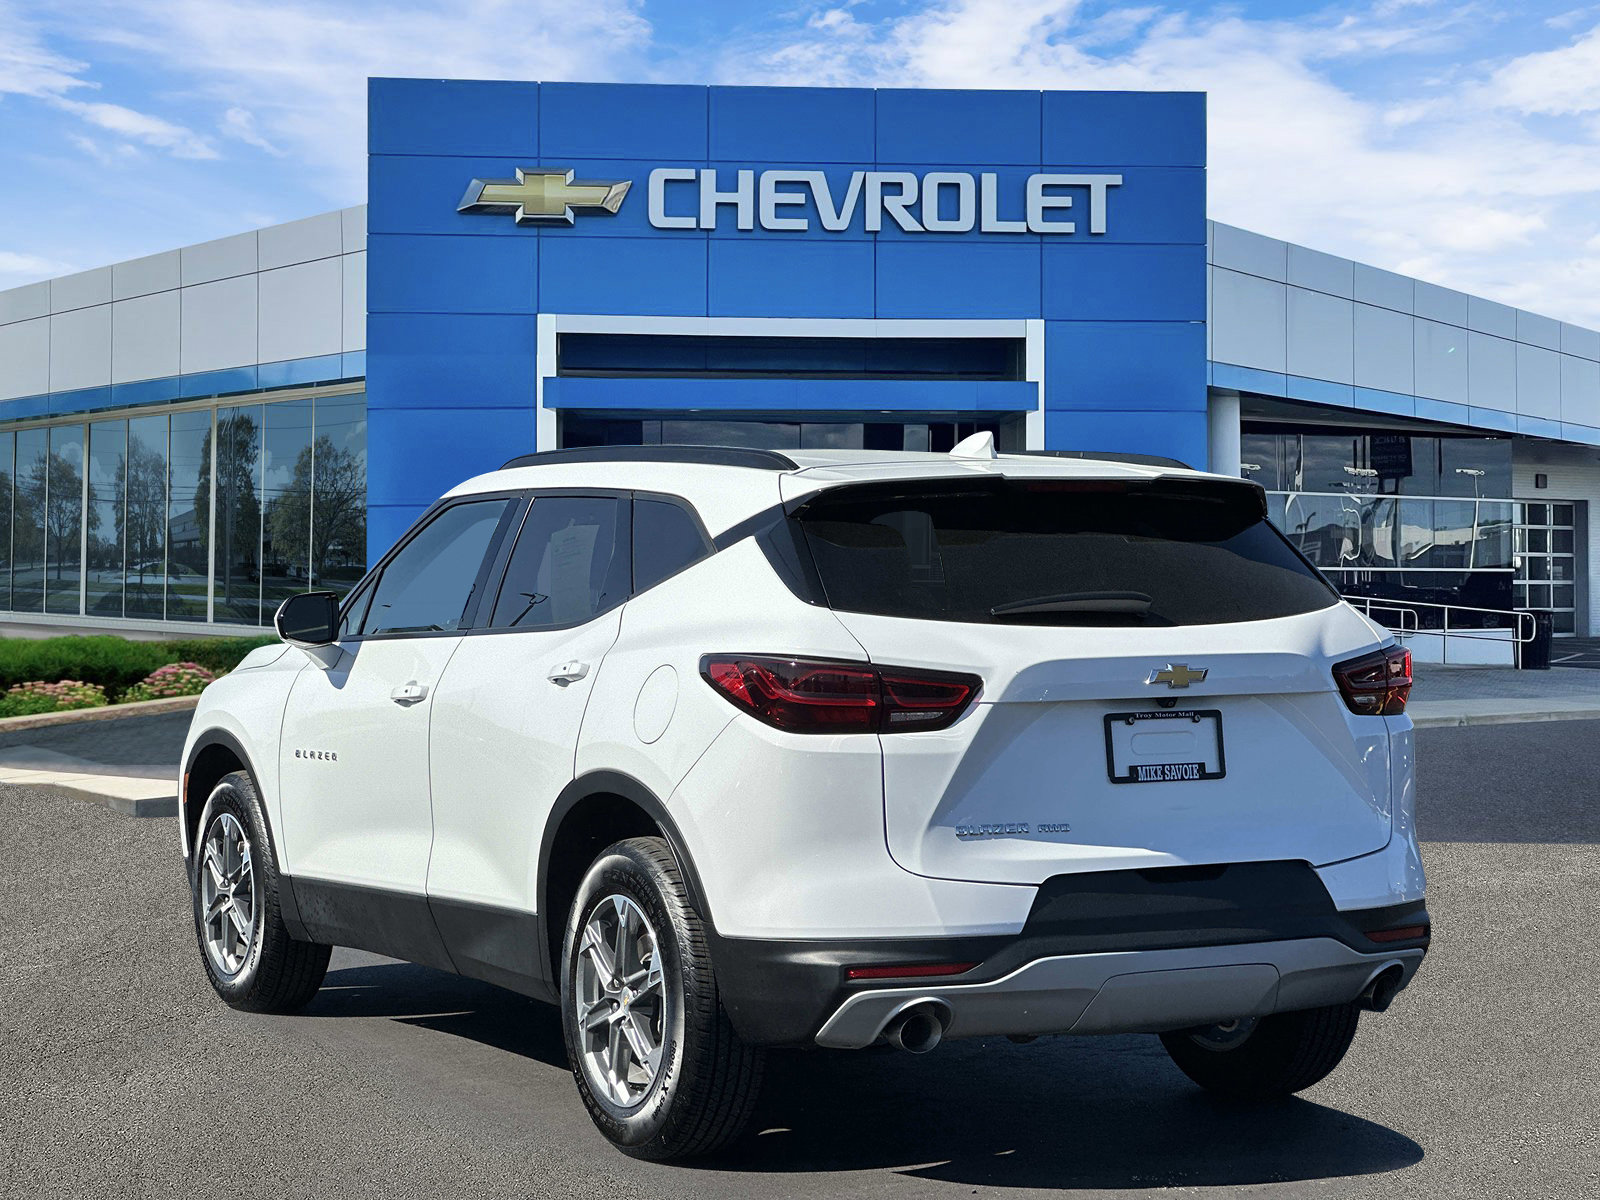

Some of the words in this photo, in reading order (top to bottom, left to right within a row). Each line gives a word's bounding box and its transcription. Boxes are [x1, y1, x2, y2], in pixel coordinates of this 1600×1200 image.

[648, 168, 1123, 235] CHEVROLET
[295, 749, 338, 762] BLAZER
[1138, 765, 1163, 781] MIKE
[1165, 764, 1199, 780] SAVOIE
[955, 822, 1030, 837] BLAZER
[1037, 822, 1071, 833] AWD
